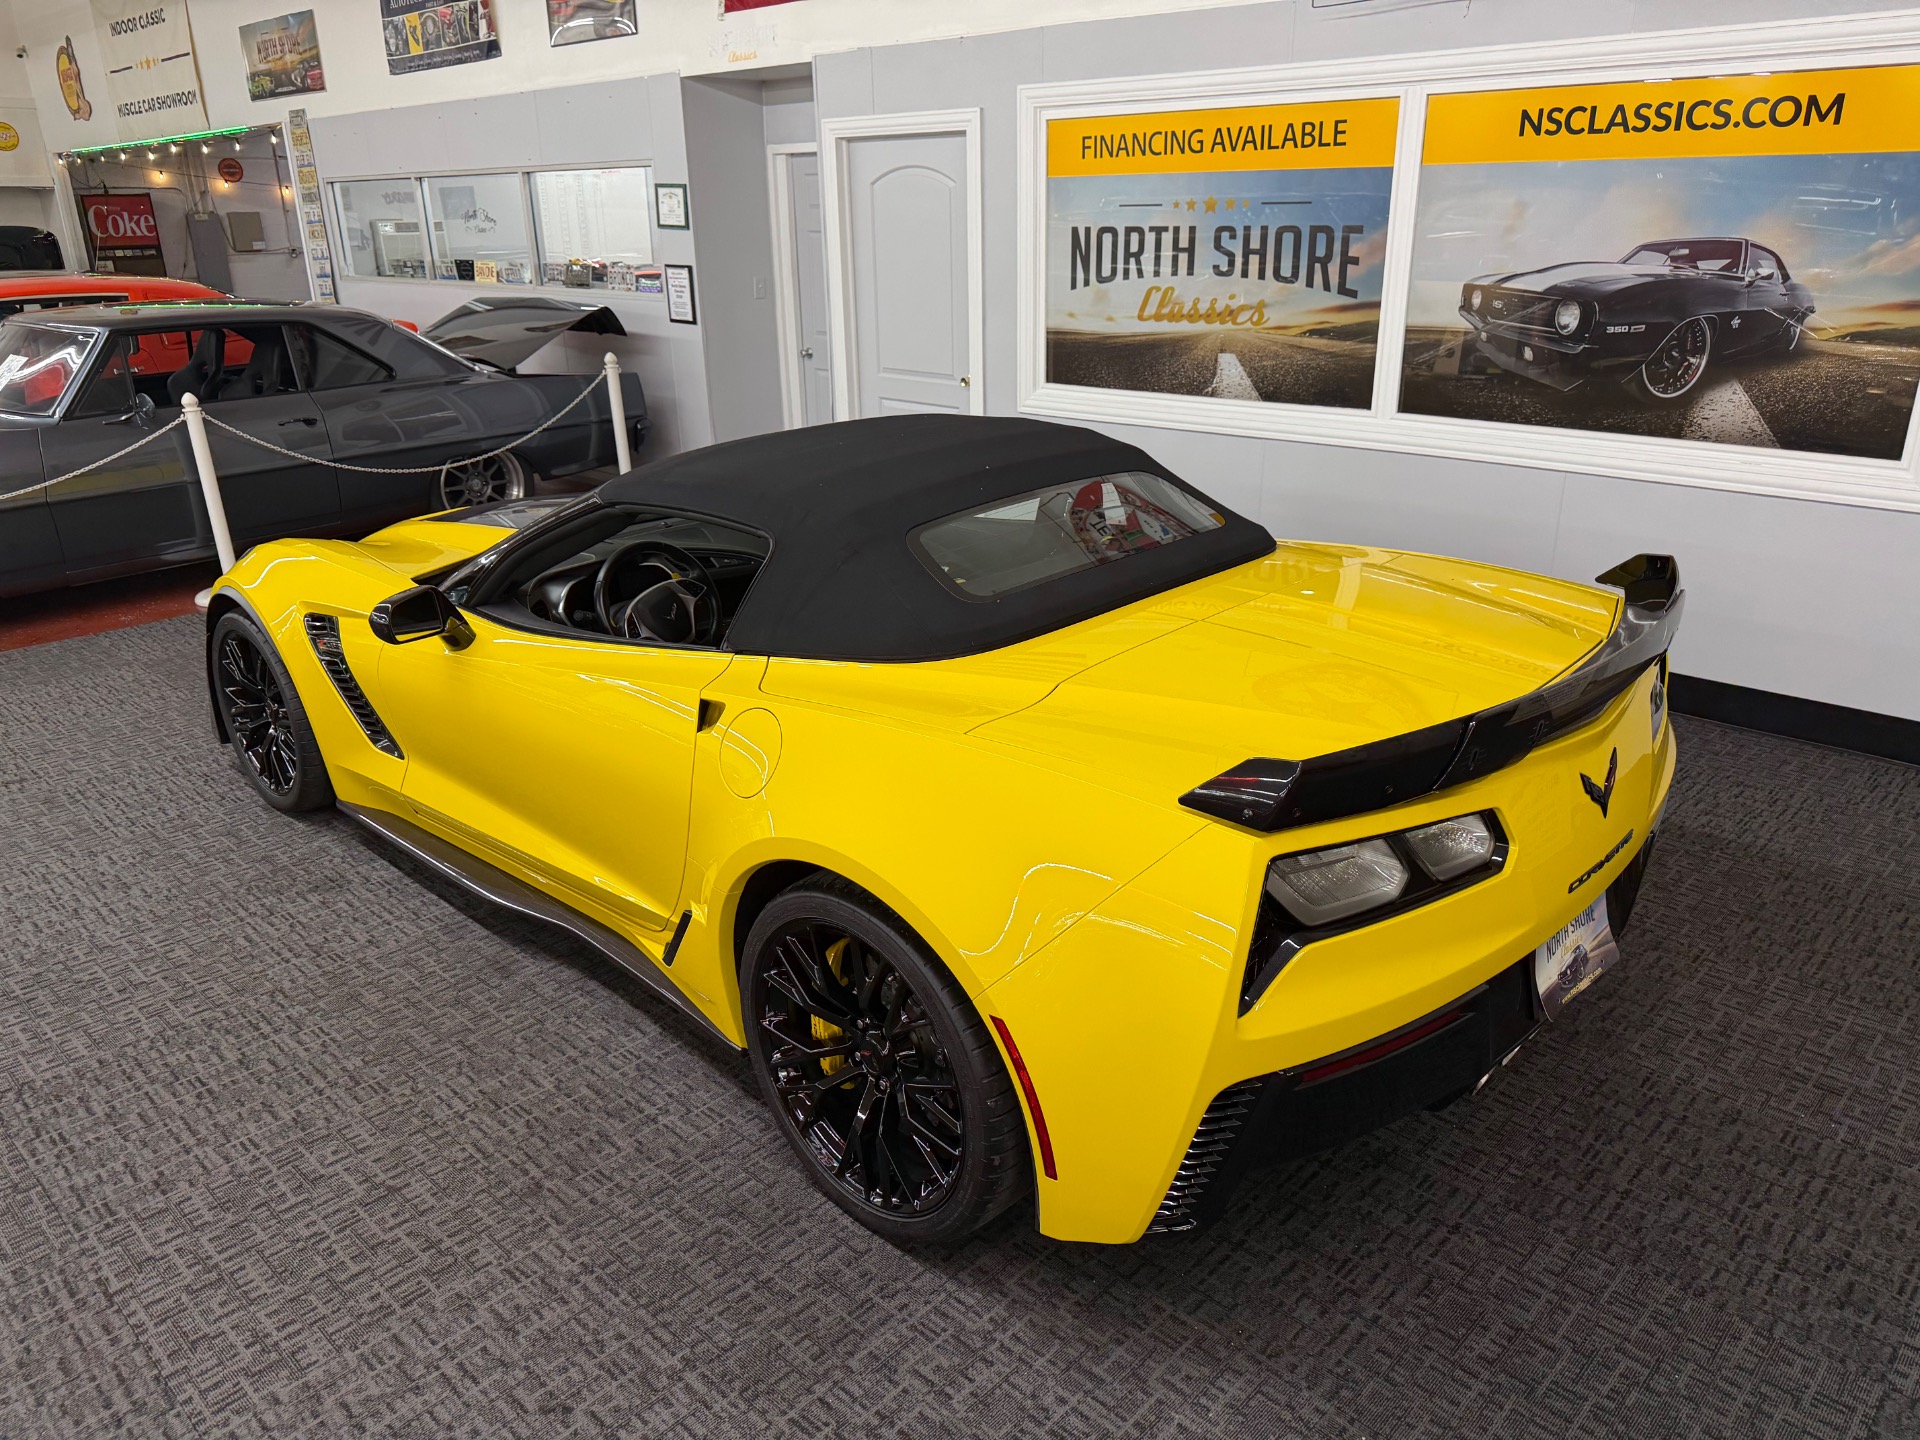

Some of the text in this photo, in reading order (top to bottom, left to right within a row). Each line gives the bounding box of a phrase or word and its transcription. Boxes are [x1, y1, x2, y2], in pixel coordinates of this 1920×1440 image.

[109, 8, 166, 37] INDOOR CLASSIC
[116, 89, 199, 118] MUSCLE CAR SHOWROOM
[1518, 92, 1846, 137] NSCLASSICS.COM
[1081, 119, 1348, 160] FINANCING AVAILABLE
[87, 204, 157, 237] Coke
[1070, 224, 1365, 299] NORTH SHORE
[1136, 285, 1271, 327] Classics
[1606, 325, 1629, 334] 350
[1546, 904, 1596, 964] NORTH SHORE
